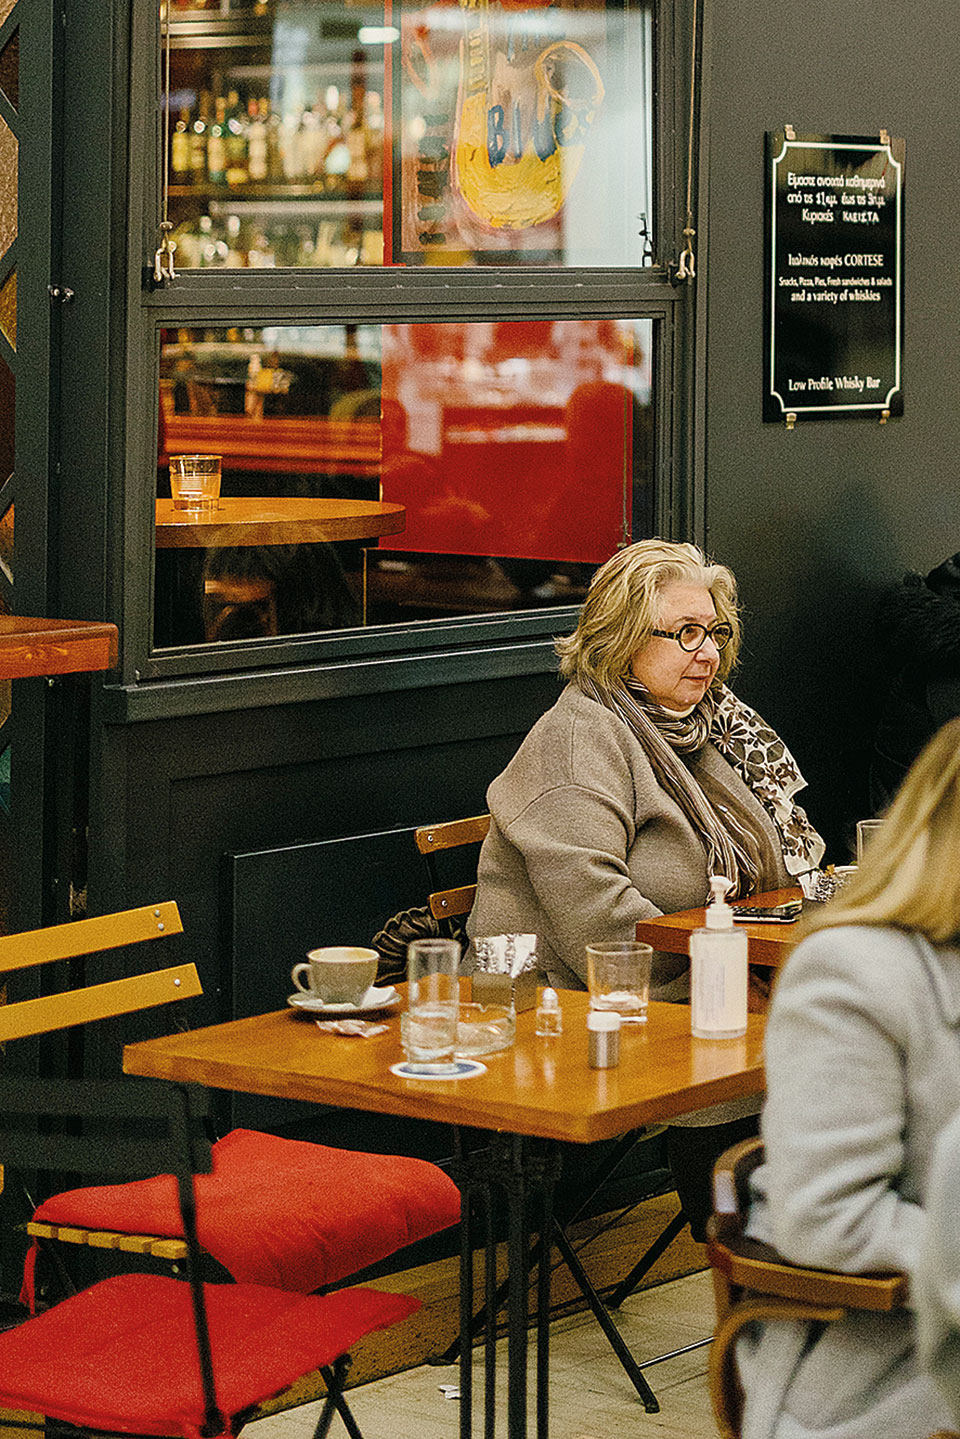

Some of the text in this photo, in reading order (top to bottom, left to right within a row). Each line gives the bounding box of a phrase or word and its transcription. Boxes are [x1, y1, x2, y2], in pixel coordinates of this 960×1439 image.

[844, 254, 884, 266] CORTESE
[791, 289, 881, 305] and a variety of whiskies
[788, 376, 881, 392] Low Profile Whisky Bar
